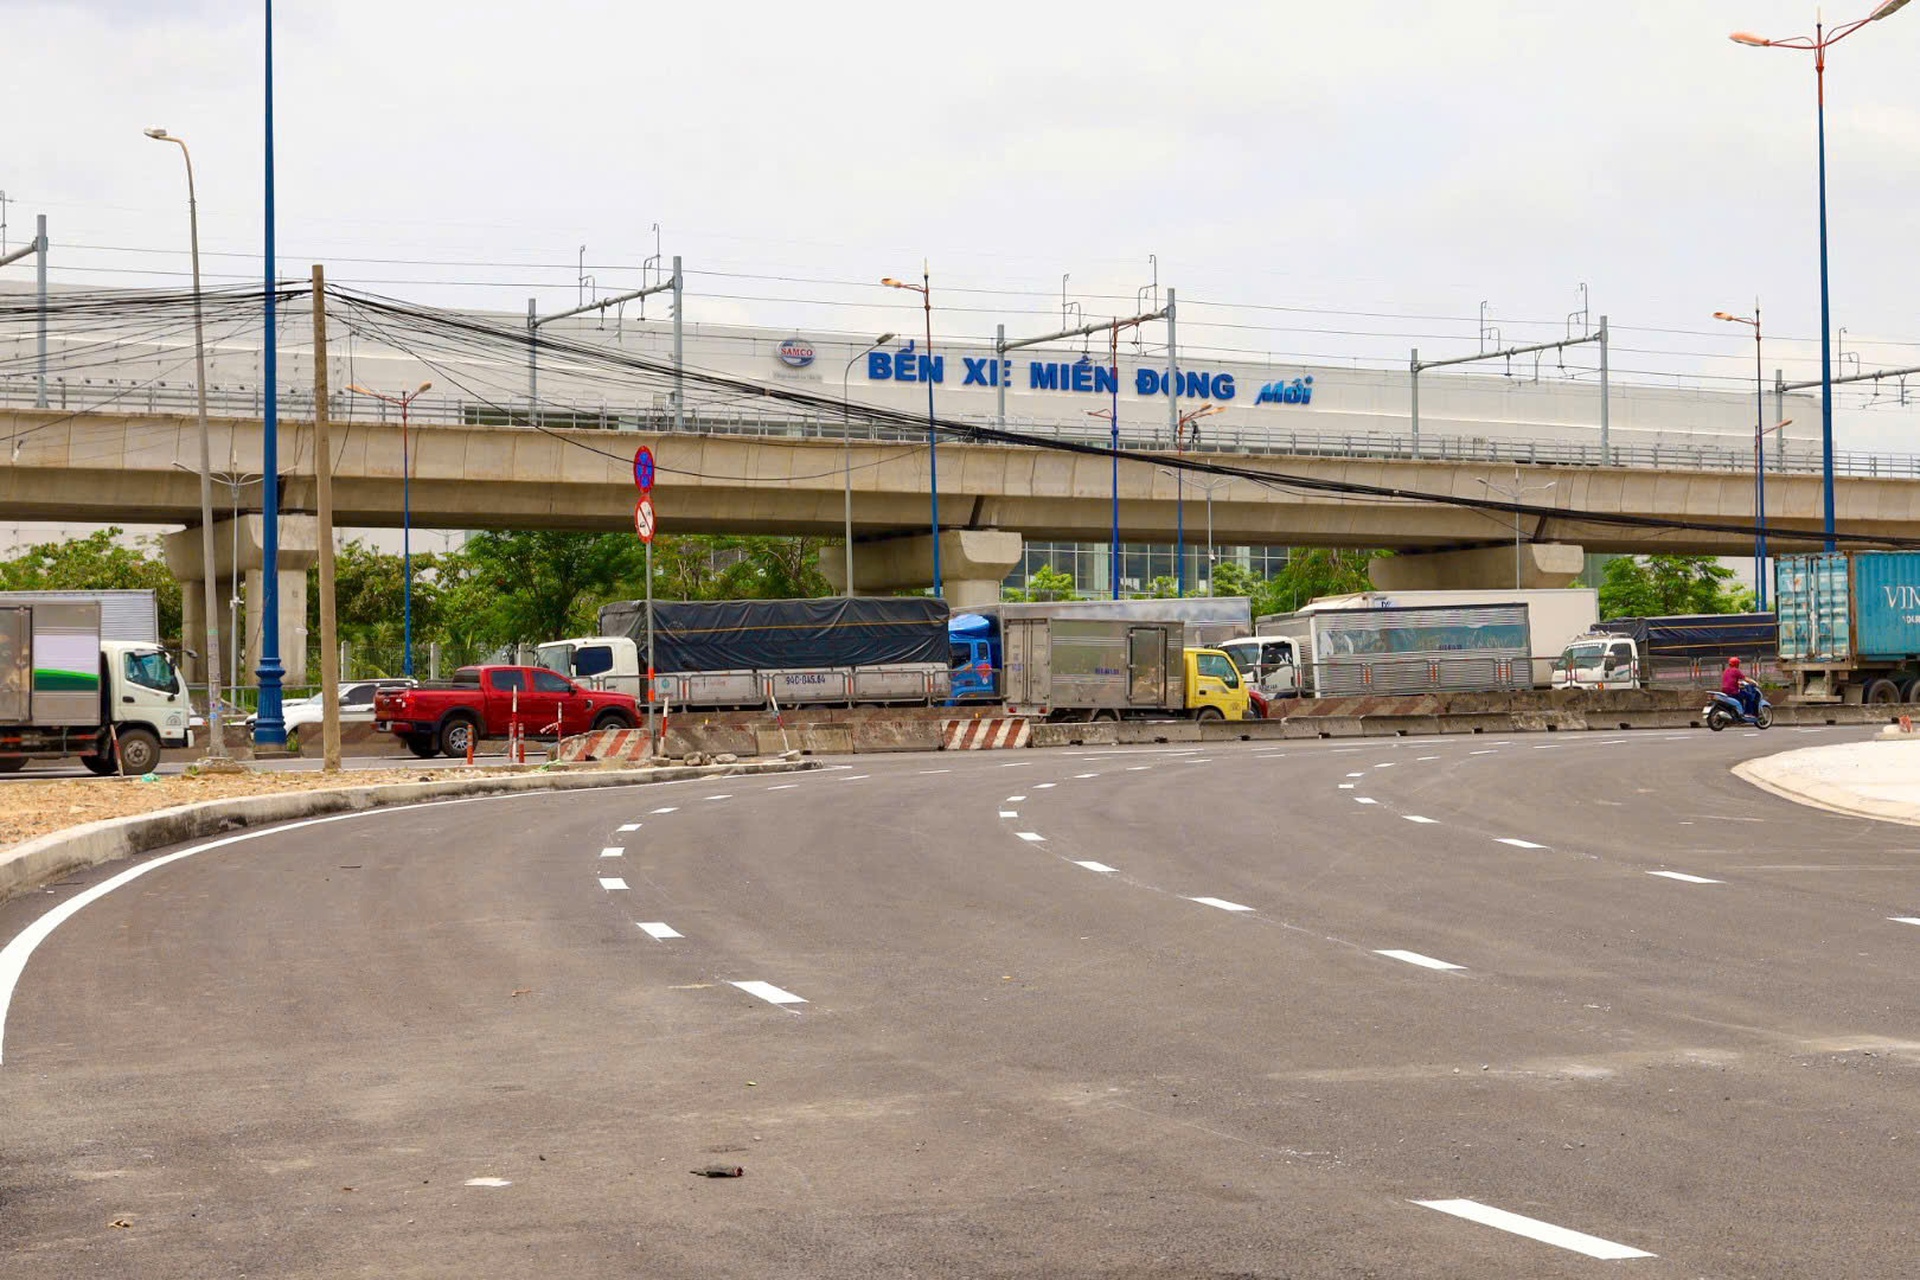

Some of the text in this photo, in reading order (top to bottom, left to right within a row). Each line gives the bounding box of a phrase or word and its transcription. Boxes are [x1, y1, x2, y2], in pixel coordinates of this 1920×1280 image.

[781, 347, 813, 356] SAMCO
[868, 339, 943, 383] BẾN
[962, 357, 1011, 387] XE
[1135, 366, 1235, 400] ĐÔNG
